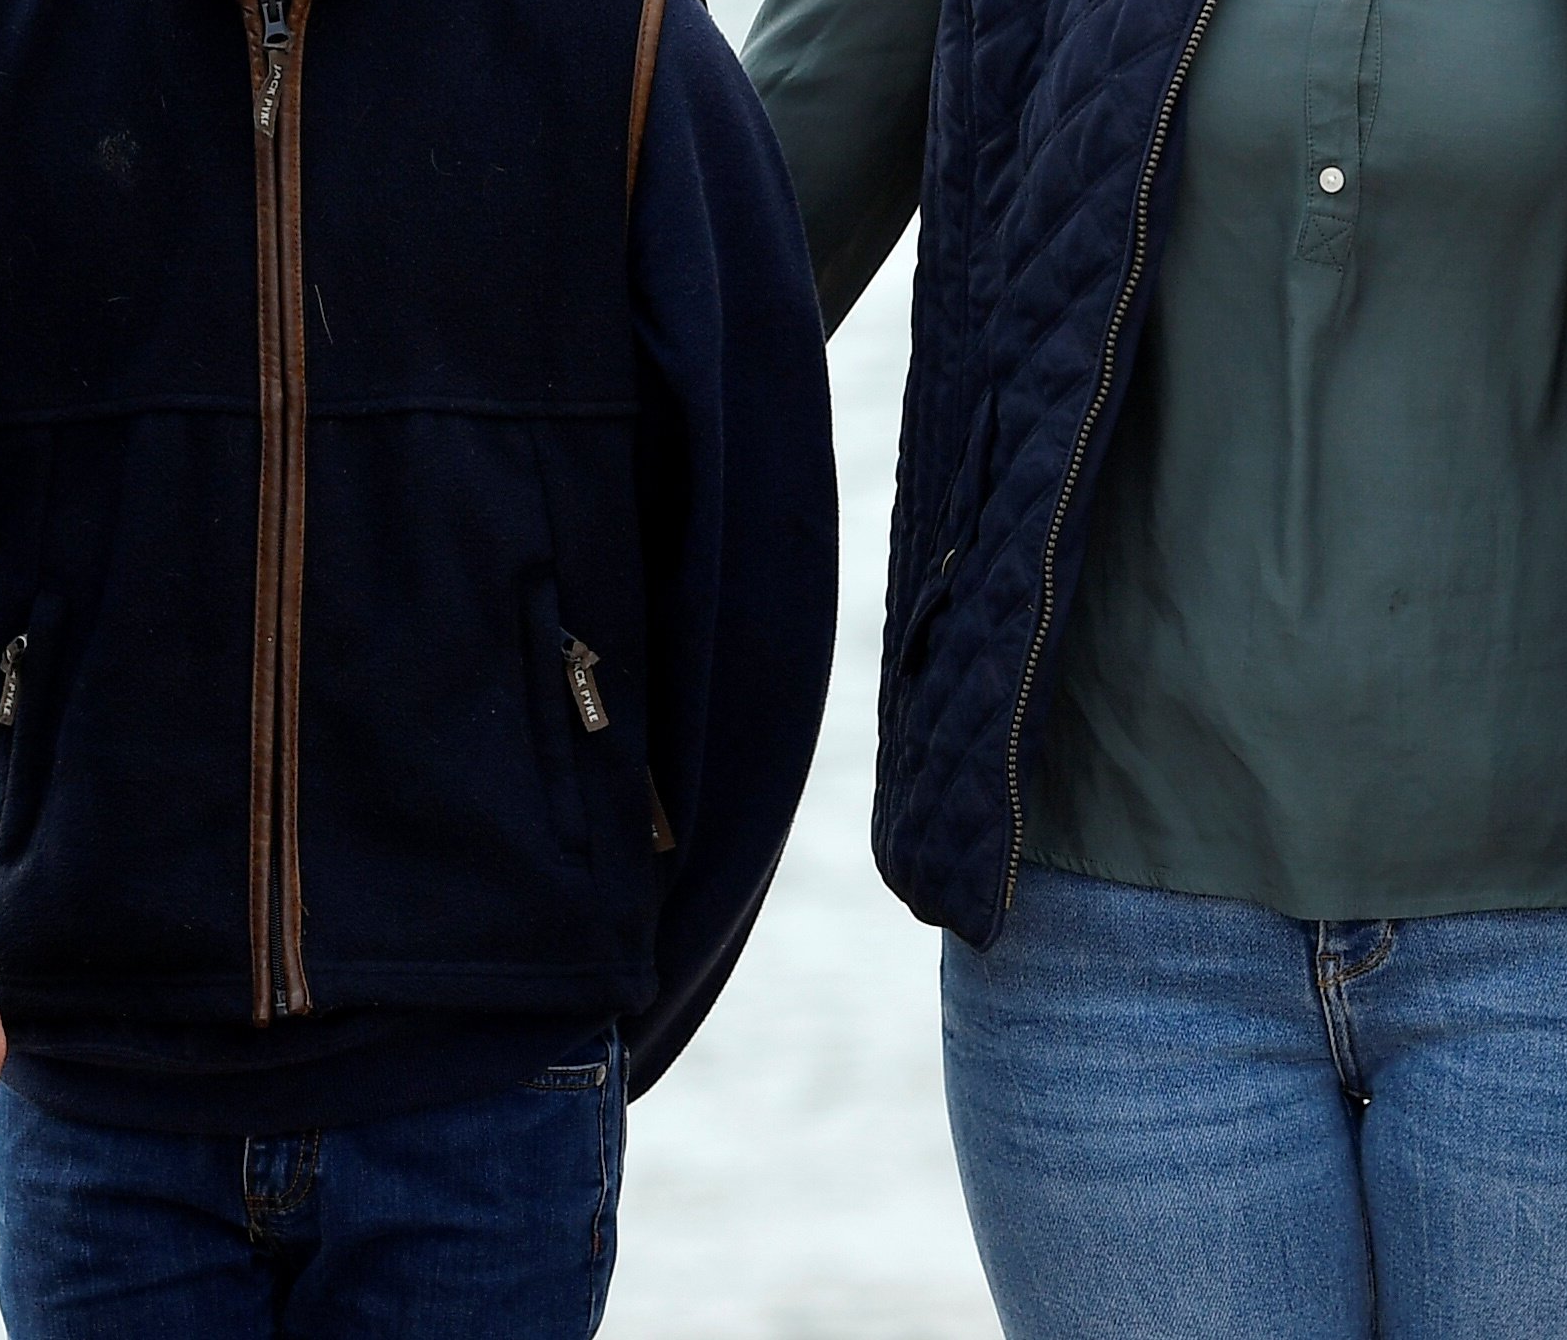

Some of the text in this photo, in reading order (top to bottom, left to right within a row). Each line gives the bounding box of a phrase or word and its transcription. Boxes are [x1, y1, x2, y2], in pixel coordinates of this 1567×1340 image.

[260, 63, 283, 127] JACK PYKE
[579, 689, 600, 723] PYKE
